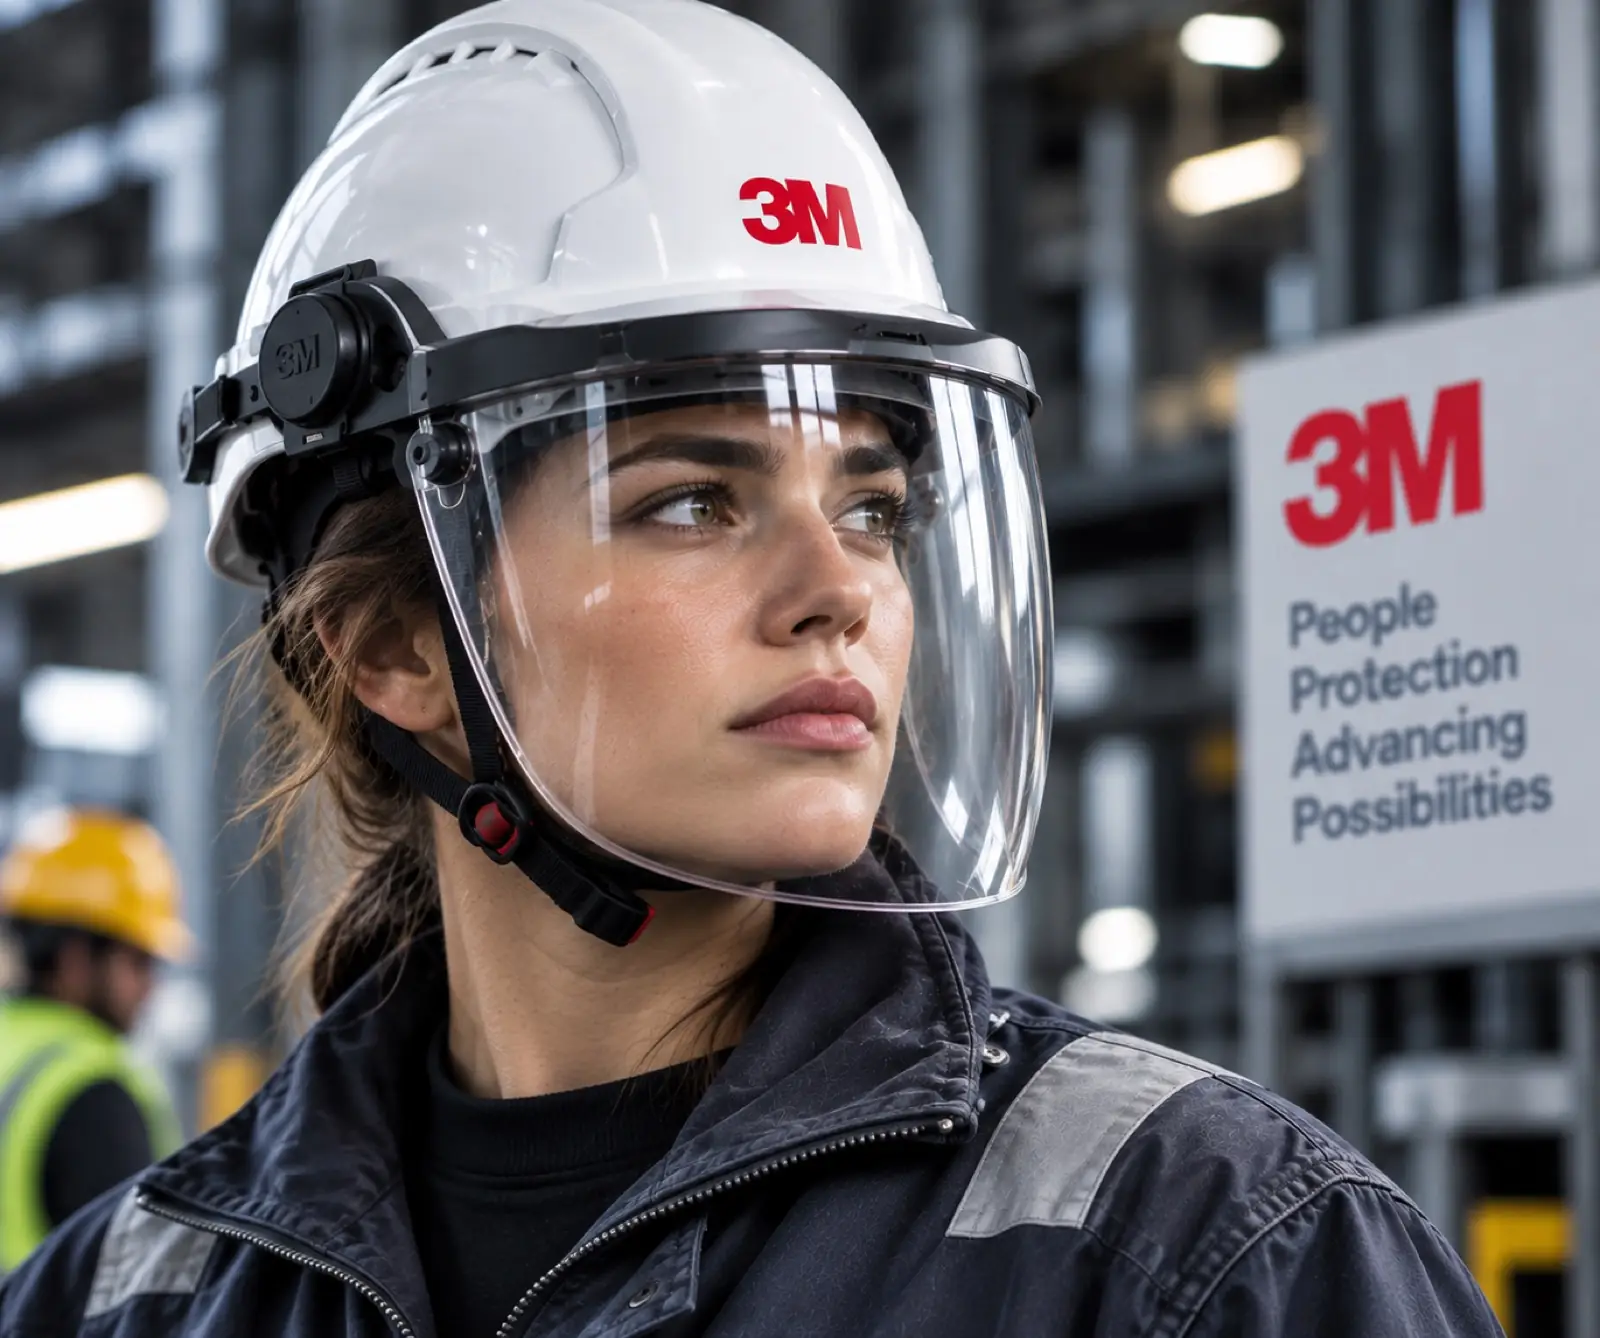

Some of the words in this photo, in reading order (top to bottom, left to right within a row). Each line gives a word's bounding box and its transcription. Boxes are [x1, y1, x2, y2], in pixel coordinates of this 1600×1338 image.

[739, 177, 862, 250] 3M
[275, 333, 320, 380] 3M
[1284, 379, 1484, 548] 3M
[1289, 582, 1437, 648] People
[1290, 640, 1519, 713] Protection
[1291, 706, 1527, 778] Advancing
[1293, 769, 1553, 843] Possibilities
